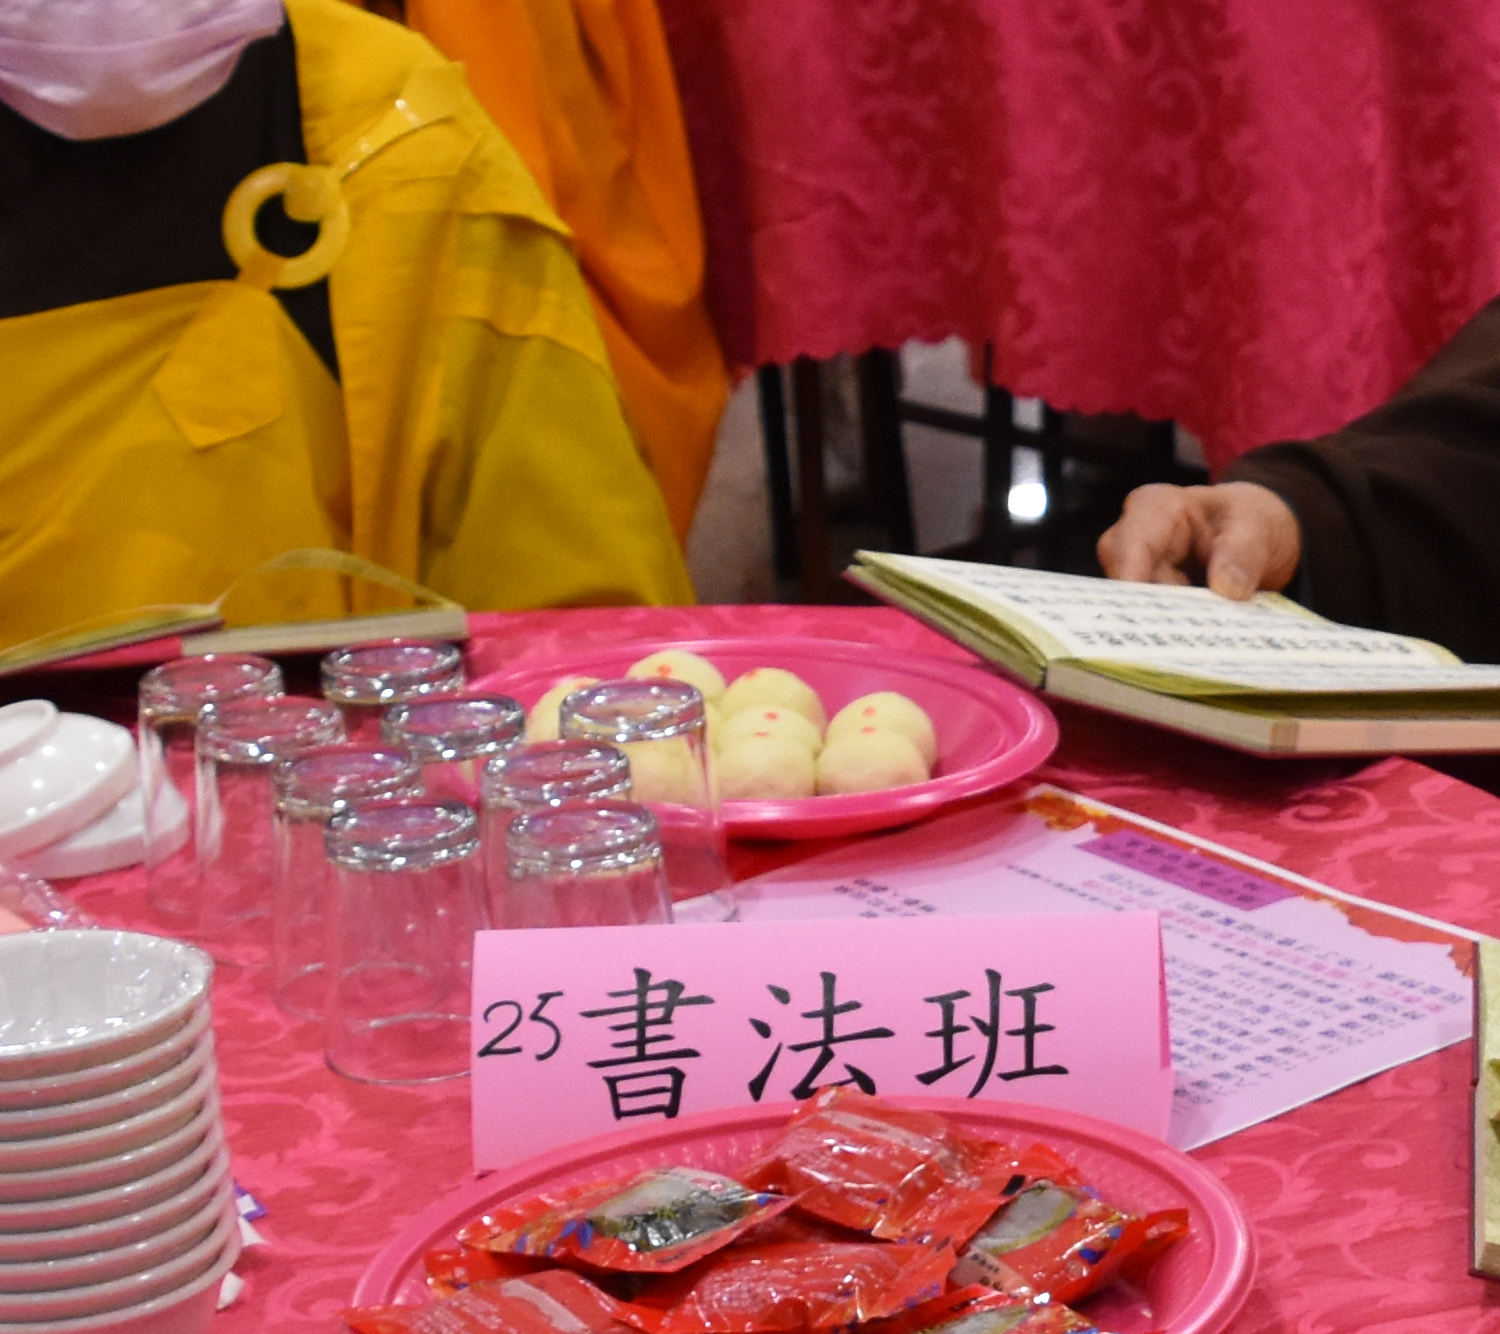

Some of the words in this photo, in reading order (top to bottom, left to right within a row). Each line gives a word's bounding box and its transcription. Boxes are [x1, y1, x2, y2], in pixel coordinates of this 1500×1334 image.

[476, 990, 564, 1062] 25
[579, 967, 1069, 1121] 書法班
